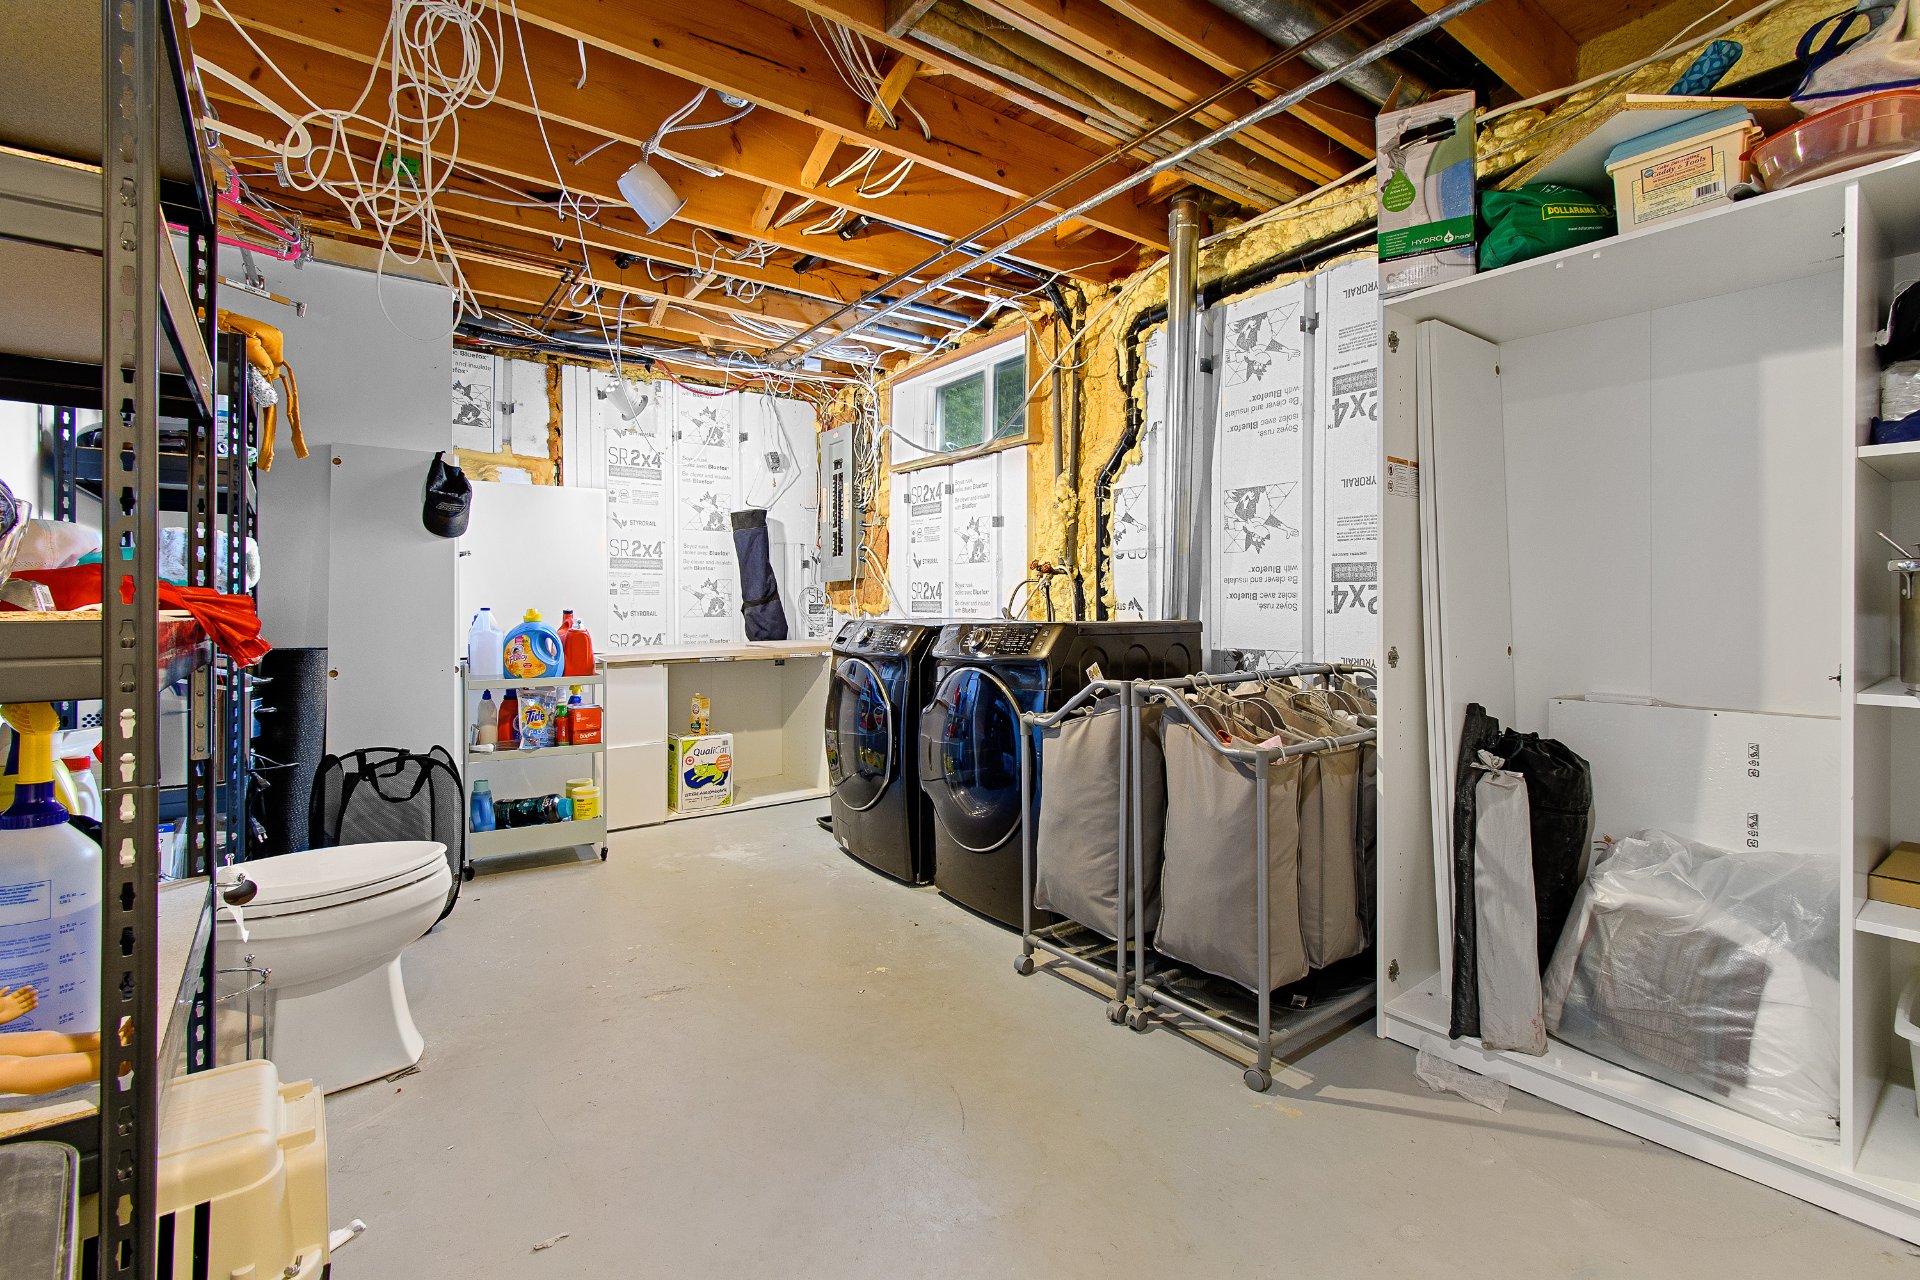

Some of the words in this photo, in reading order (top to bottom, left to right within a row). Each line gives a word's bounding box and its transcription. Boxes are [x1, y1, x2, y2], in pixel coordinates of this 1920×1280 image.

[1685, 156, 1706, 167] Tools
[1548, 206, 1597, 214] DOLLARAMA
[1412, 235, 1442, 246] HYDRO
[1342, 280, 1378, 298] YRORAIL
[1284, 386, 1299, 394] with
[1266, 399, 1287, 409] clever
[1289, 397, 1299, 406] Be
[1225, 408, 1249, 418] insulate
[1251, 404, 1264, 413] and
[1261, 417, 1276, 426] avec
[1279, 413, 1299, 422] isolez
[1277, 424, 1298, 434] Soyez
[1341, 476, 1376, 488] YRORAIL
[1284, 565, 1298, 573] with
[1224, 577, 1248, 586] insulate
[1265, 576, 1286, 584] clever
[1288, 576, 1298, 584] Be
[1278, 592, 1298, 600] isolez
[1276, 601, 1298, 611] Soyez
[526, 710, 545, 725] Tide
[694, 746, 728, 757] QualiCat
